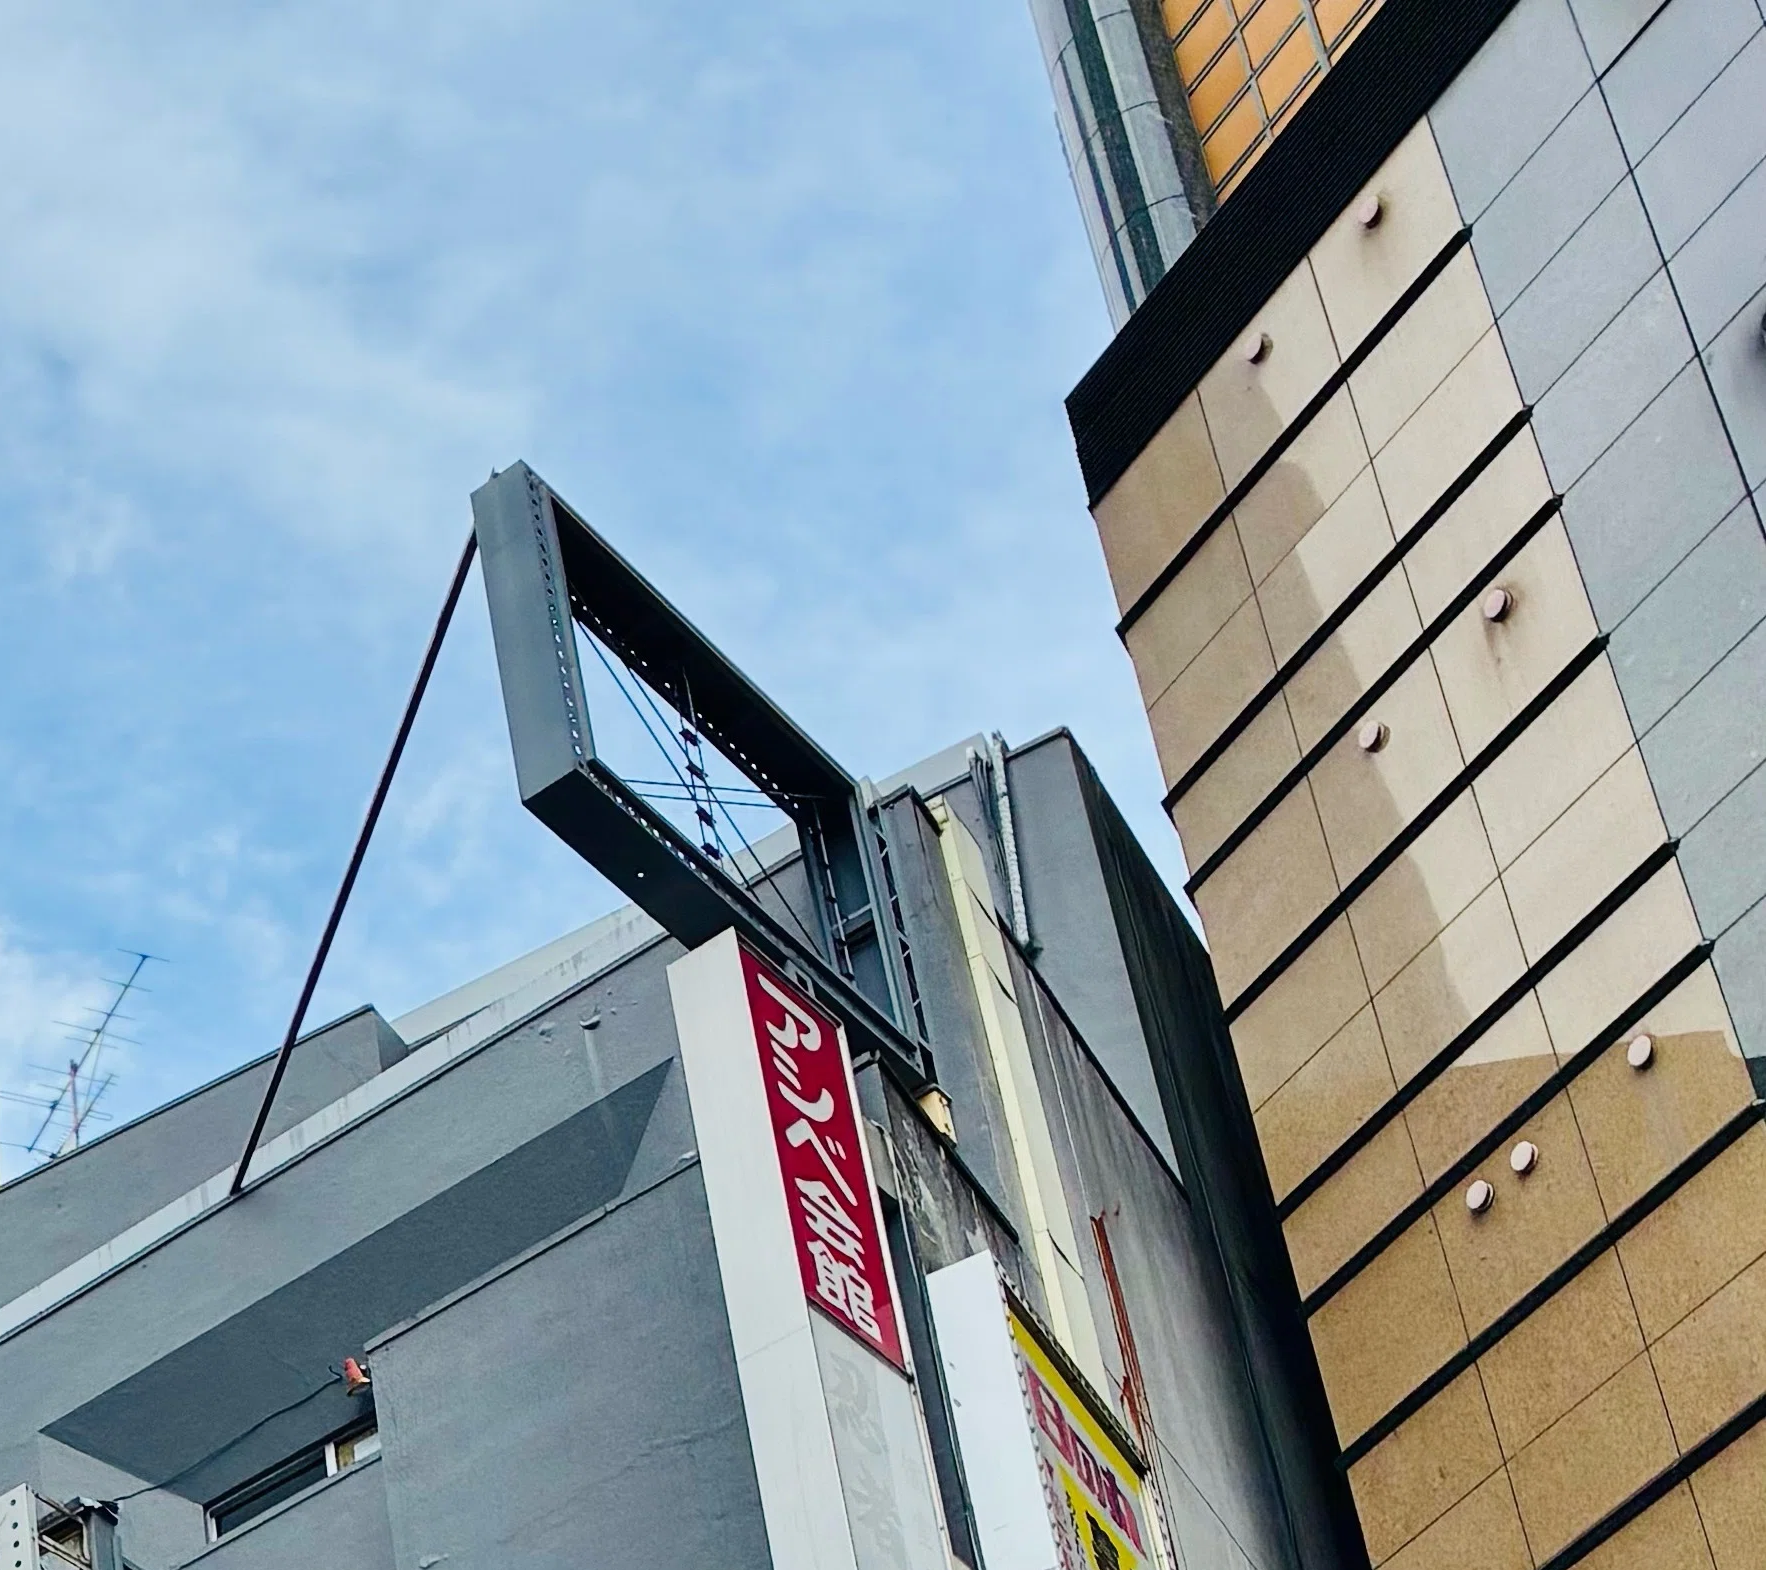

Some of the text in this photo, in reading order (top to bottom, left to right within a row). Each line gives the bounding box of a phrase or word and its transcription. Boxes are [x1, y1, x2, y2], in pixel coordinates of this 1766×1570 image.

[757, 973, 884, 1343] アシベ会館
[1025, 1362, 1148, 1560] 日の丸
